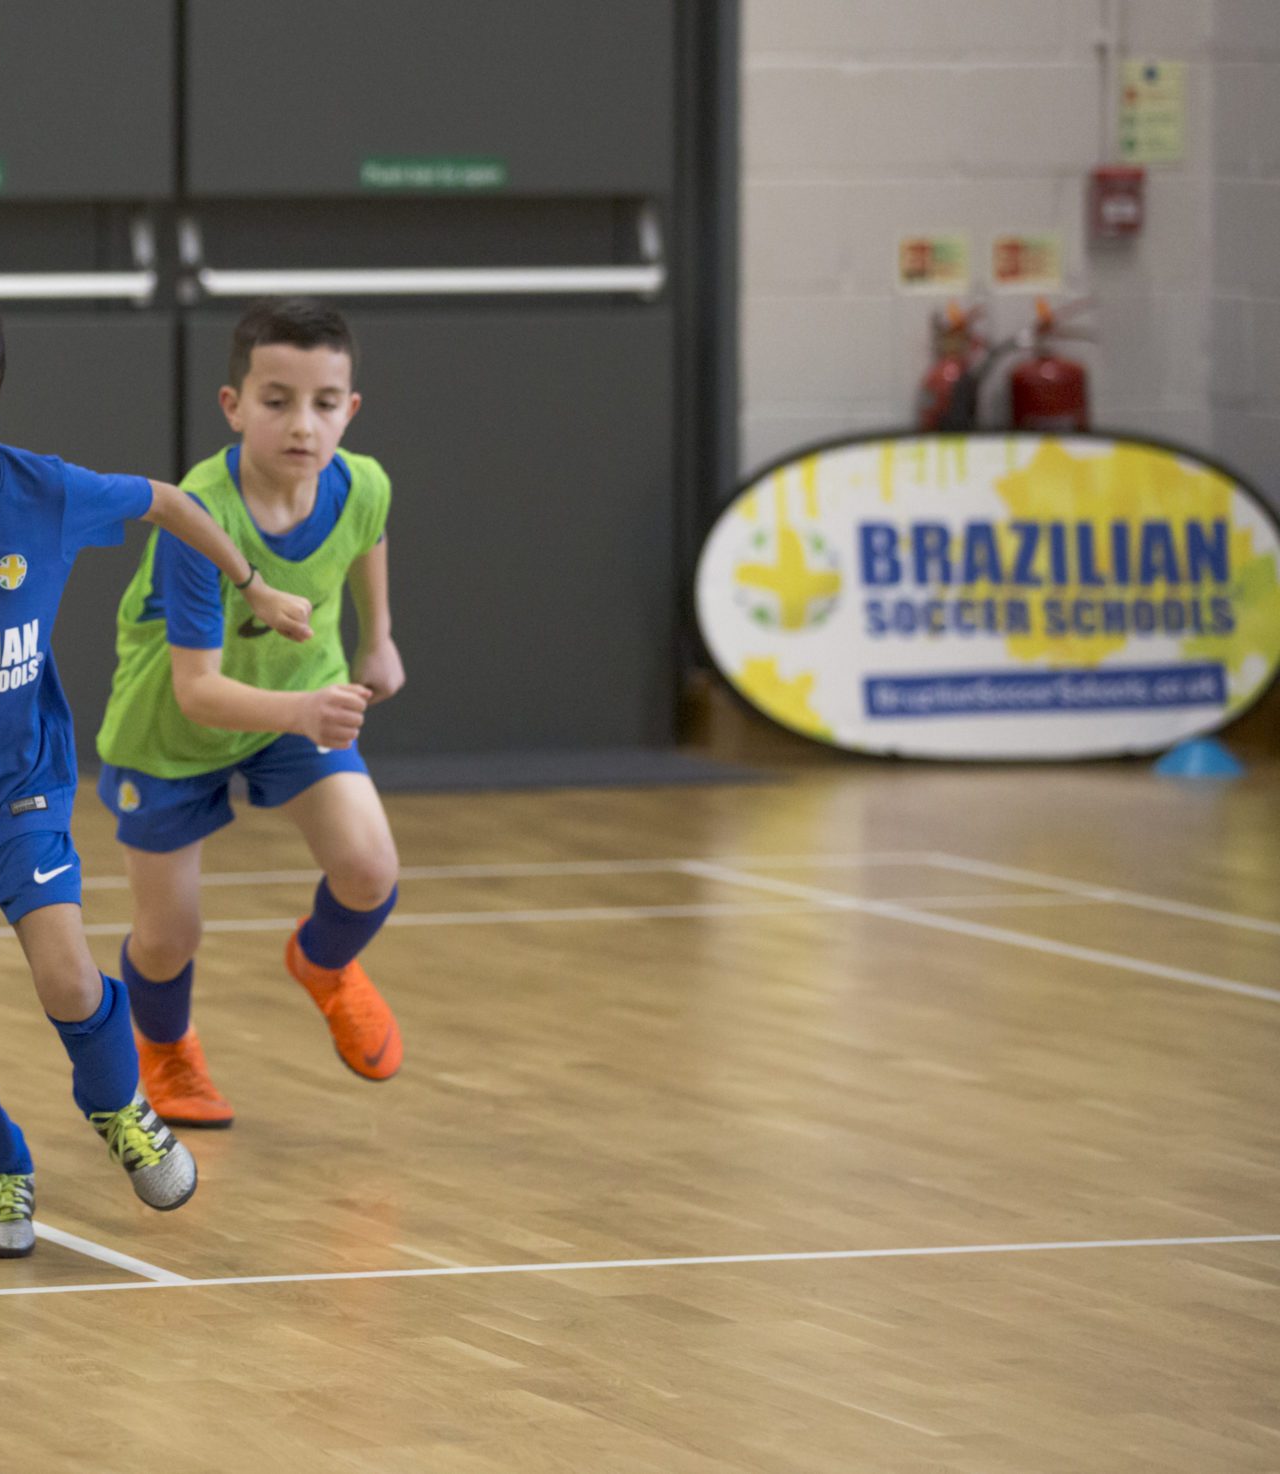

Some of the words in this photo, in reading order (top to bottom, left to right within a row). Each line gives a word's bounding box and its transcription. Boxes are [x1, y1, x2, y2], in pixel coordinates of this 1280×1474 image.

[859, 521, 1230, 586] BRAZILIAN
[865, 598, 1033, 638] SOCCER
[1044, 598, 1235, 638] SCHOOLS
